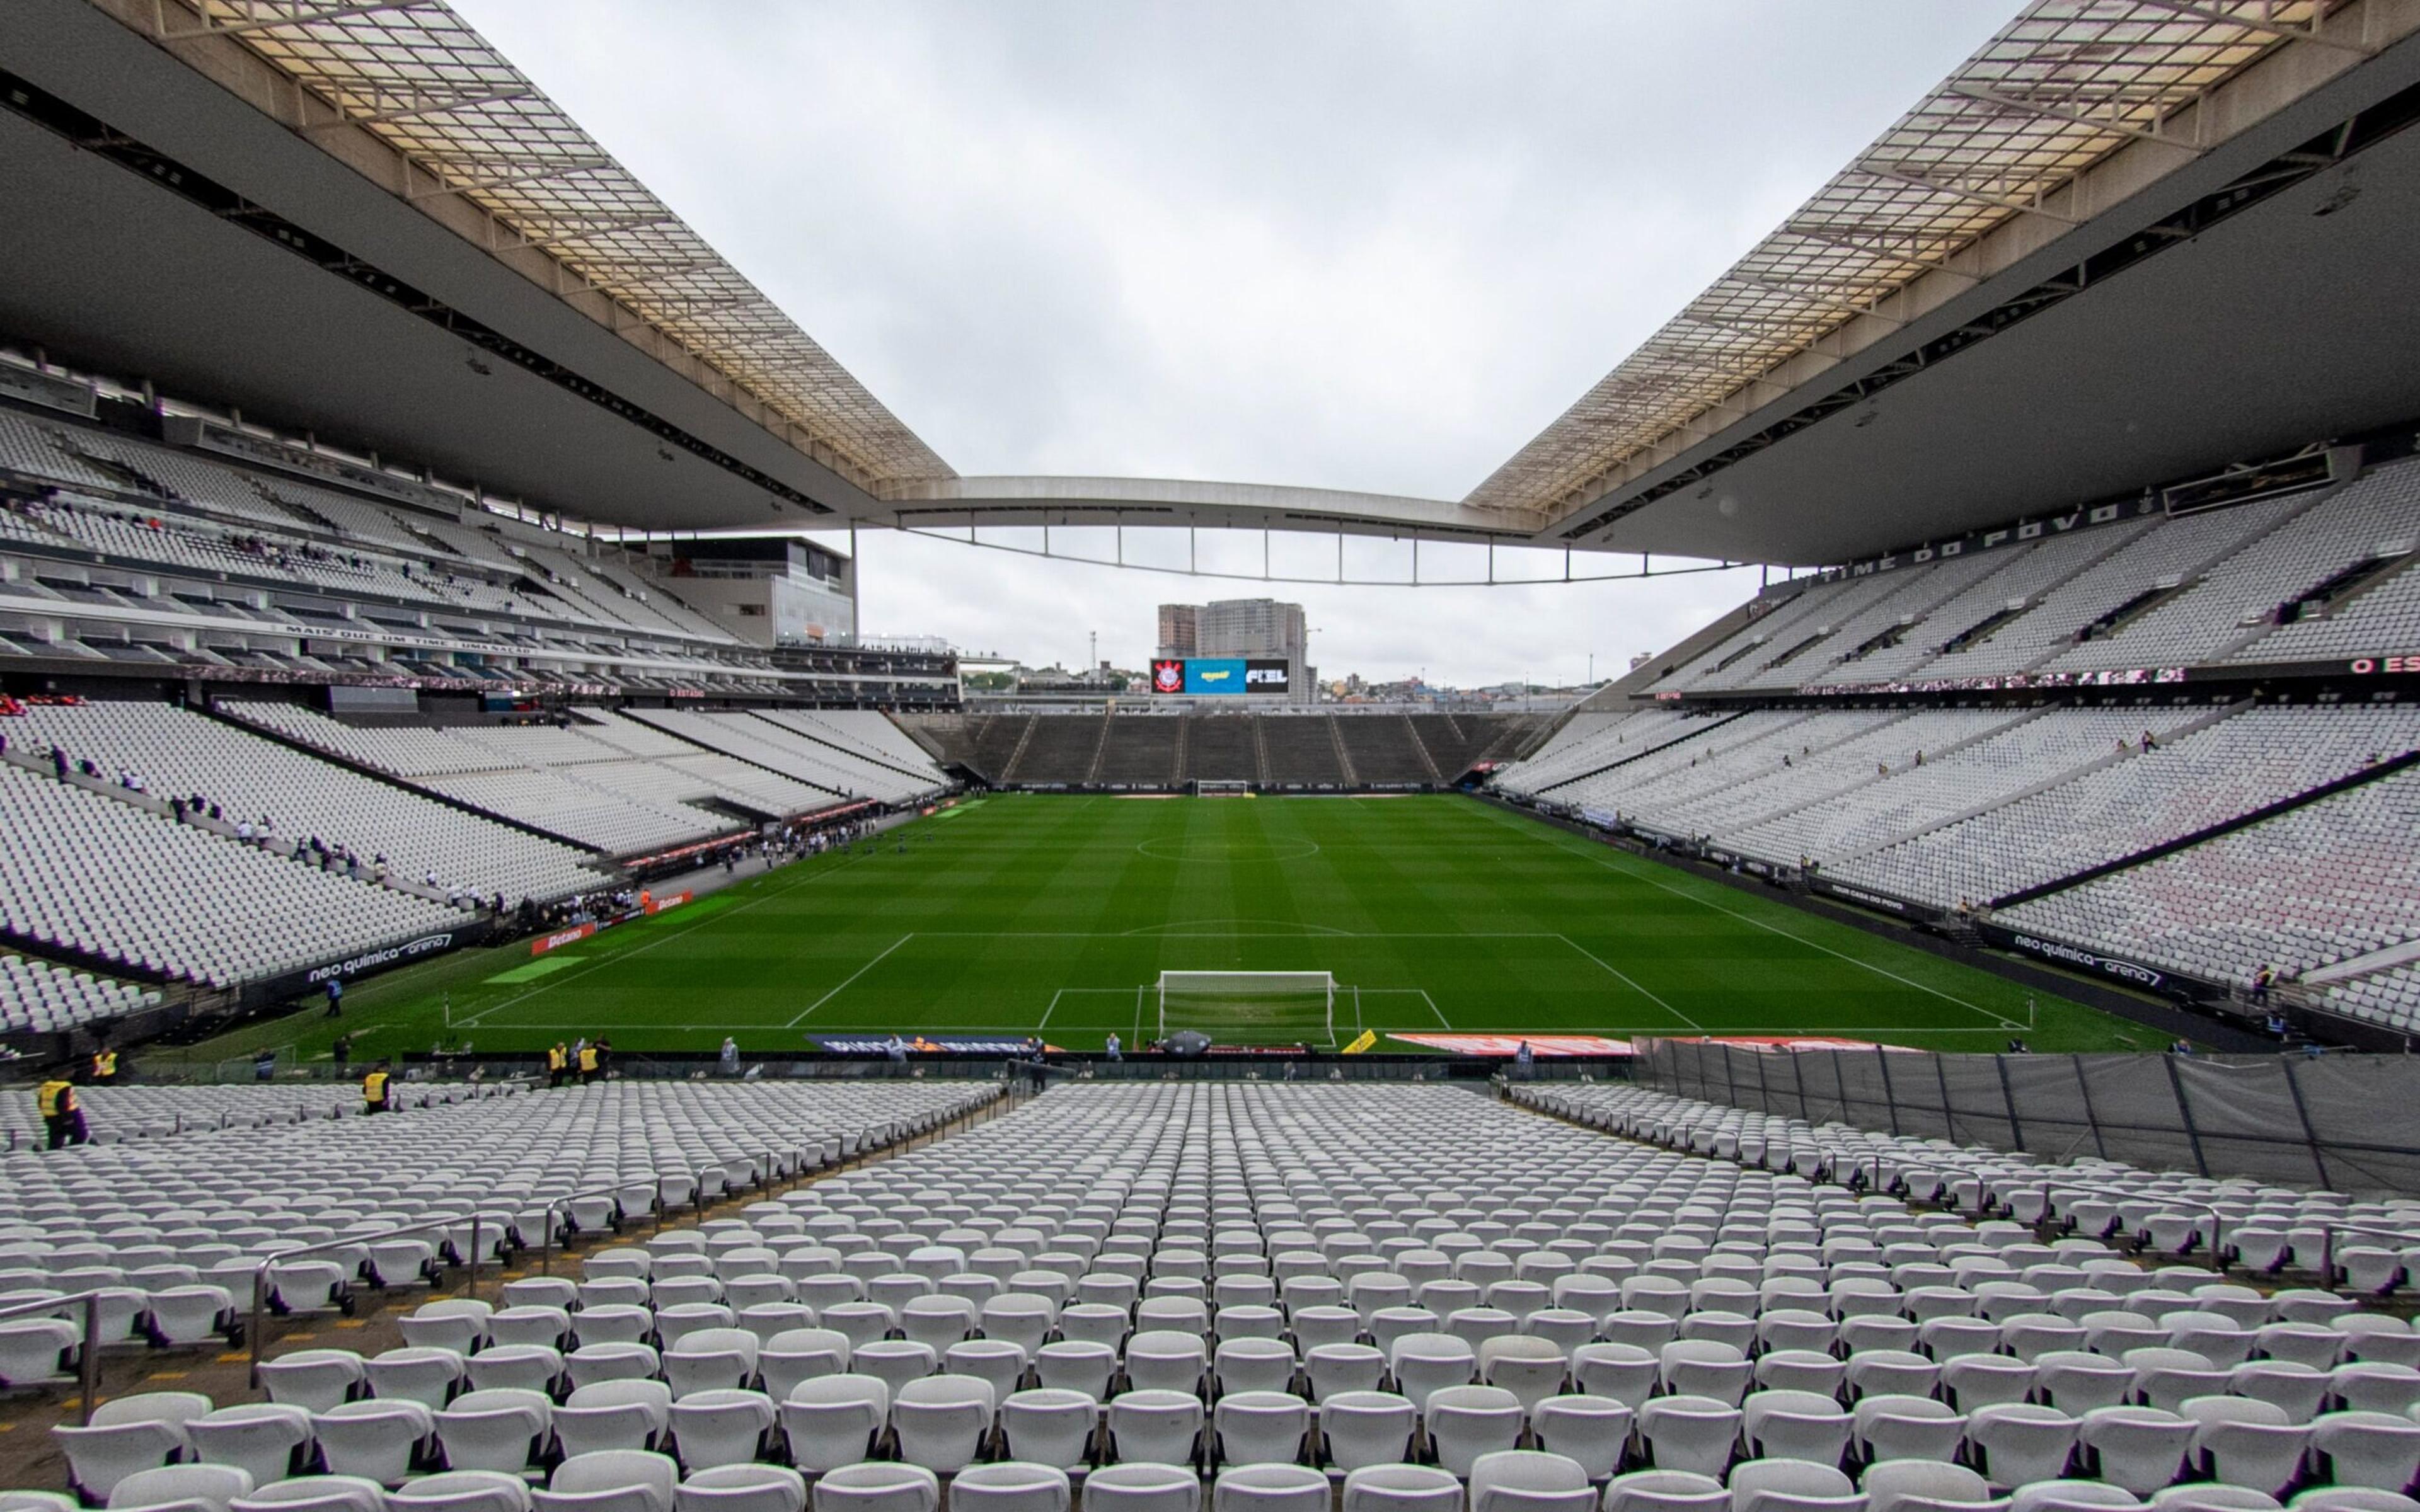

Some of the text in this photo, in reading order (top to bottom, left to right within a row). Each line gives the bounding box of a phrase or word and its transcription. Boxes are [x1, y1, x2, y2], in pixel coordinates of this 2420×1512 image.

[1821, 504, 2118, 583] TIME DO POVO
[286, 626, 333, 636] MAIS
[340, 631, 377, 641] QUE
[415, 638, 449, 648] TIME
[462, 643, 492, 651] UMA
[2350, 658, 2373, 674] O
[1831, 885, 1850, 895] TOUR
[1850, 890, 1869, 900] CASA
[1869, 895, 1881, 904] DO
[548, 929, 582, 949] Betano
[309, 937, 443, 983] neo química arena
[2015, 935, 2148, 982] neo química arena
